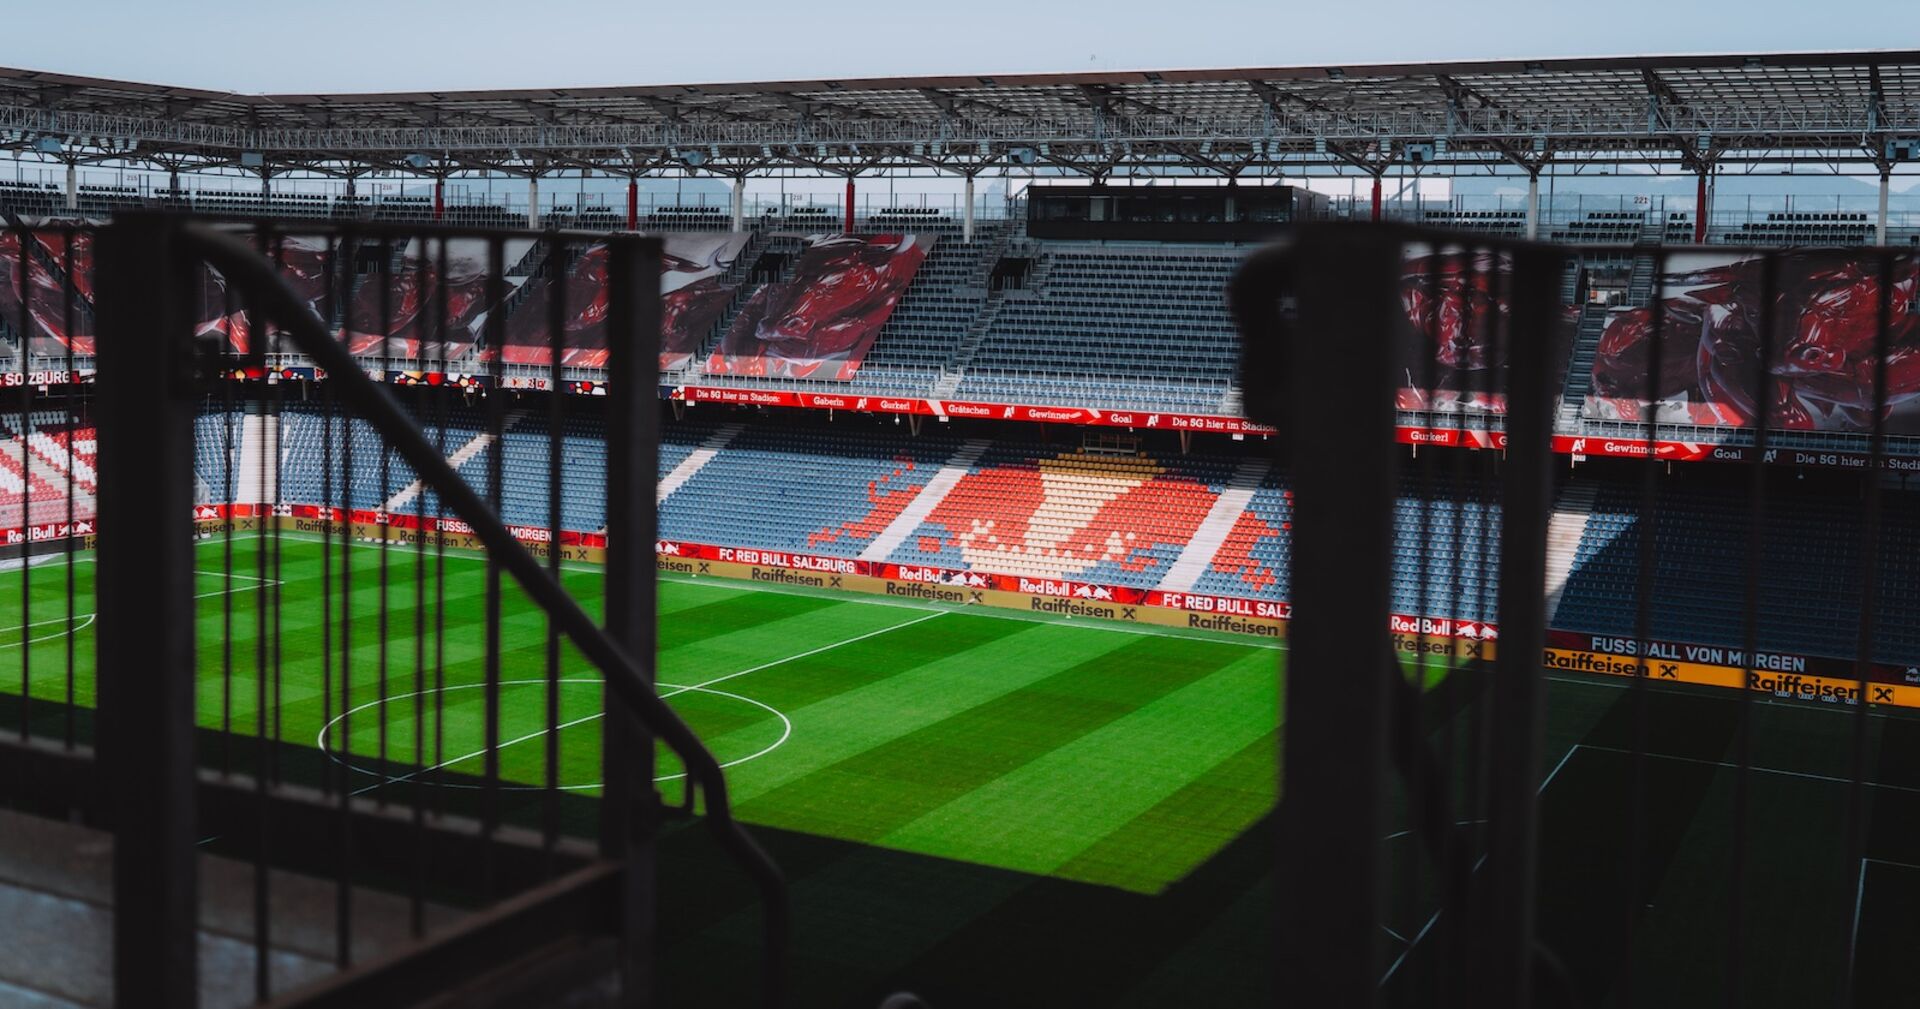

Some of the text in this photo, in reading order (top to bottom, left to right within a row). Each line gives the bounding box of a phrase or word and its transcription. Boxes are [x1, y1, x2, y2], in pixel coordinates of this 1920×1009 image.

[696, 389, 709, 399] Die
[722, 391, 737, 400] hier
[739, 392, 748, 401] im
[1028, 408, 1071, 420] Gewinner
[1111, 413, 1133, 424] Goal
[1172, 416, 1188, 427] Die
[1206, 419, 1224, 429] hier
[1227, 420, 1239, 430] im
[1410, 430, 1449, 443] Gurkerl
[1713, 448, 1742, 460] Goal
[1796, 453, 1816, 464] Die
[1841, 456, 1865, 467] hier
[33, 524, 55, 540] Bull
[510, 527, 552, 542] MORGEN
[719, 548, 855, 574] FC RED BULL SALZBURG
[752, 567, 824, 587] Raiffeisen
[899, 566, 922, 580] Red
[886, 582, 963, 602] Raiffeisen
[1019, 578, 1070, 596] Red Bull
[1031, 597, 1114, 618] Raiffeisen
[1163, 593, 1182, 608] FC
[1185, 595, 1213, 611] RED
[1217, 598, 1253, 615] BULL
[1188, 613, 1279, 637] Raiffeisen
[1391, 616, 1450, 636] Red Bull
[1592, 636, 1805, 672] FUSSBALL VON MORGEN
[1543, 650, 1650, 677] Raiffeisen
[1746, 671, 1859, 700] Raiffeisen
